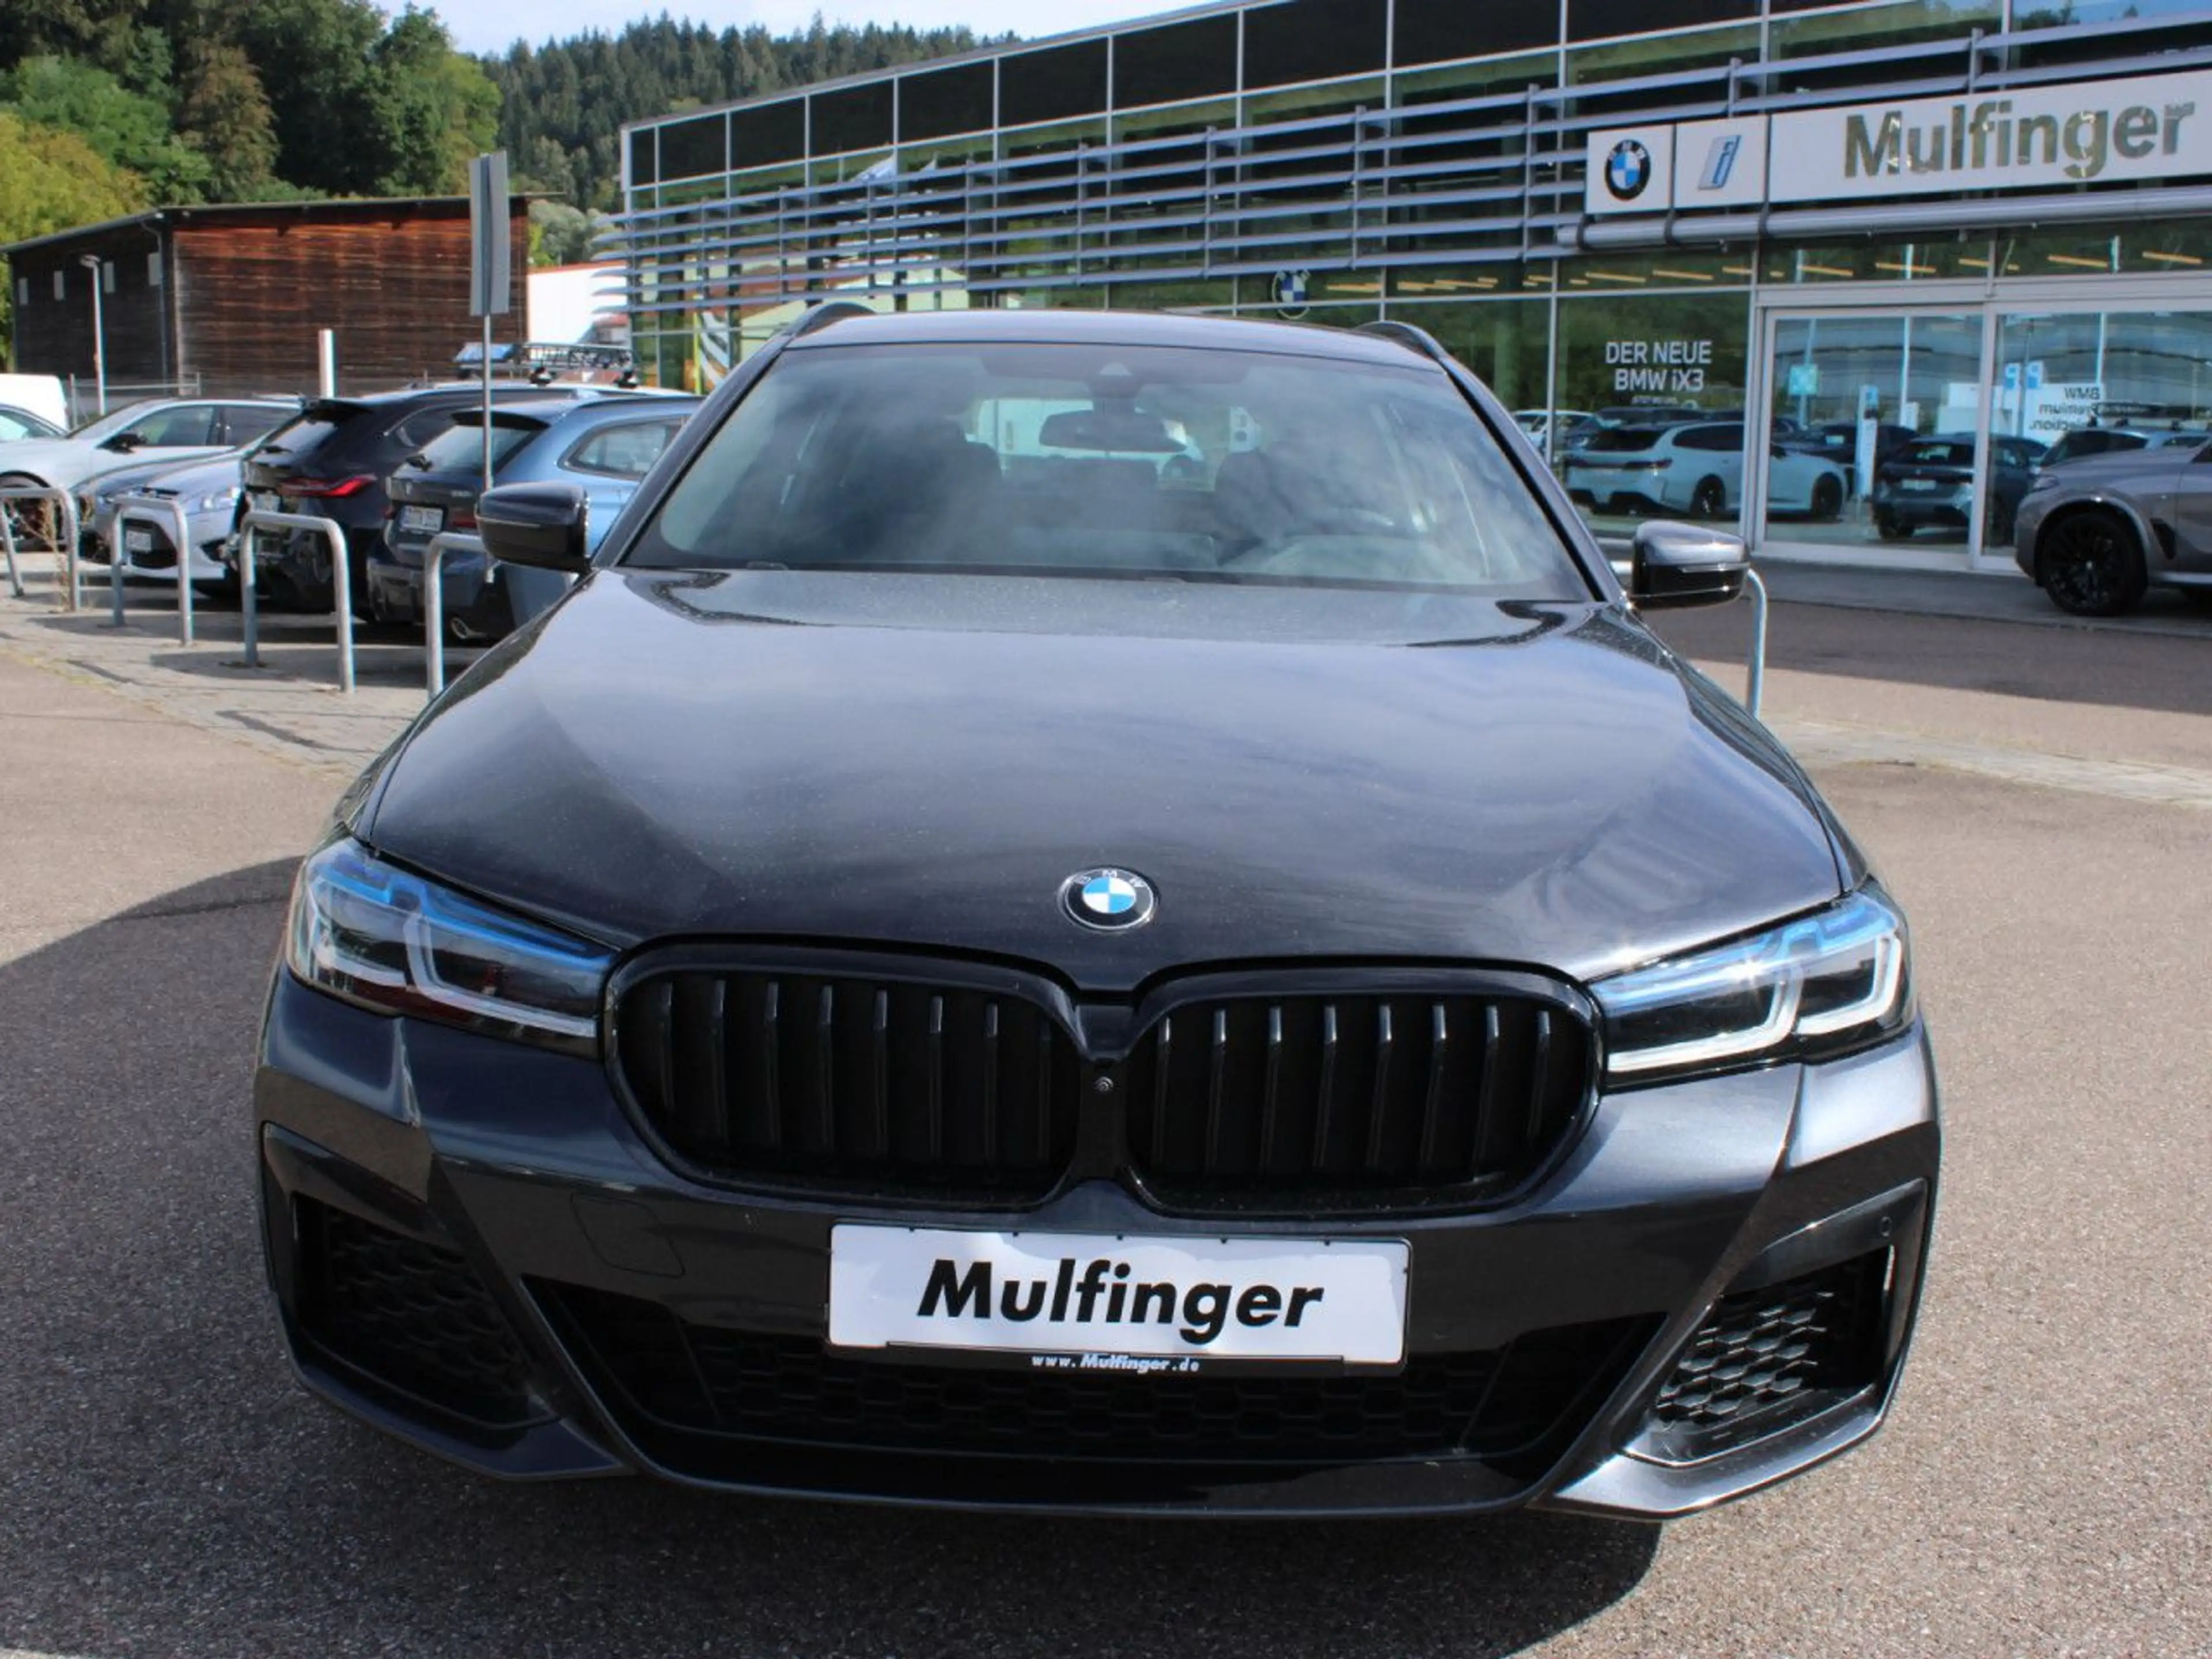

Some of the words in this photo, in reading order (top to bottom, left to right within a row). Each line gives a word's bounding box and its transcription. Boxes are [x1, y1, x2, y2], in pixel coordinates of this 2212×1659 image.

[1845, 100, 2195, 179] Mulfinger
[1605, 340, 1647, 364] DER
[1653, 340, 1712, 364] NEUE
[1615, 368, 1667, 391] BMW
[1672, 368, 1704, 391] iX3
[917, 1259, 1324, 1345] Mulfinger
